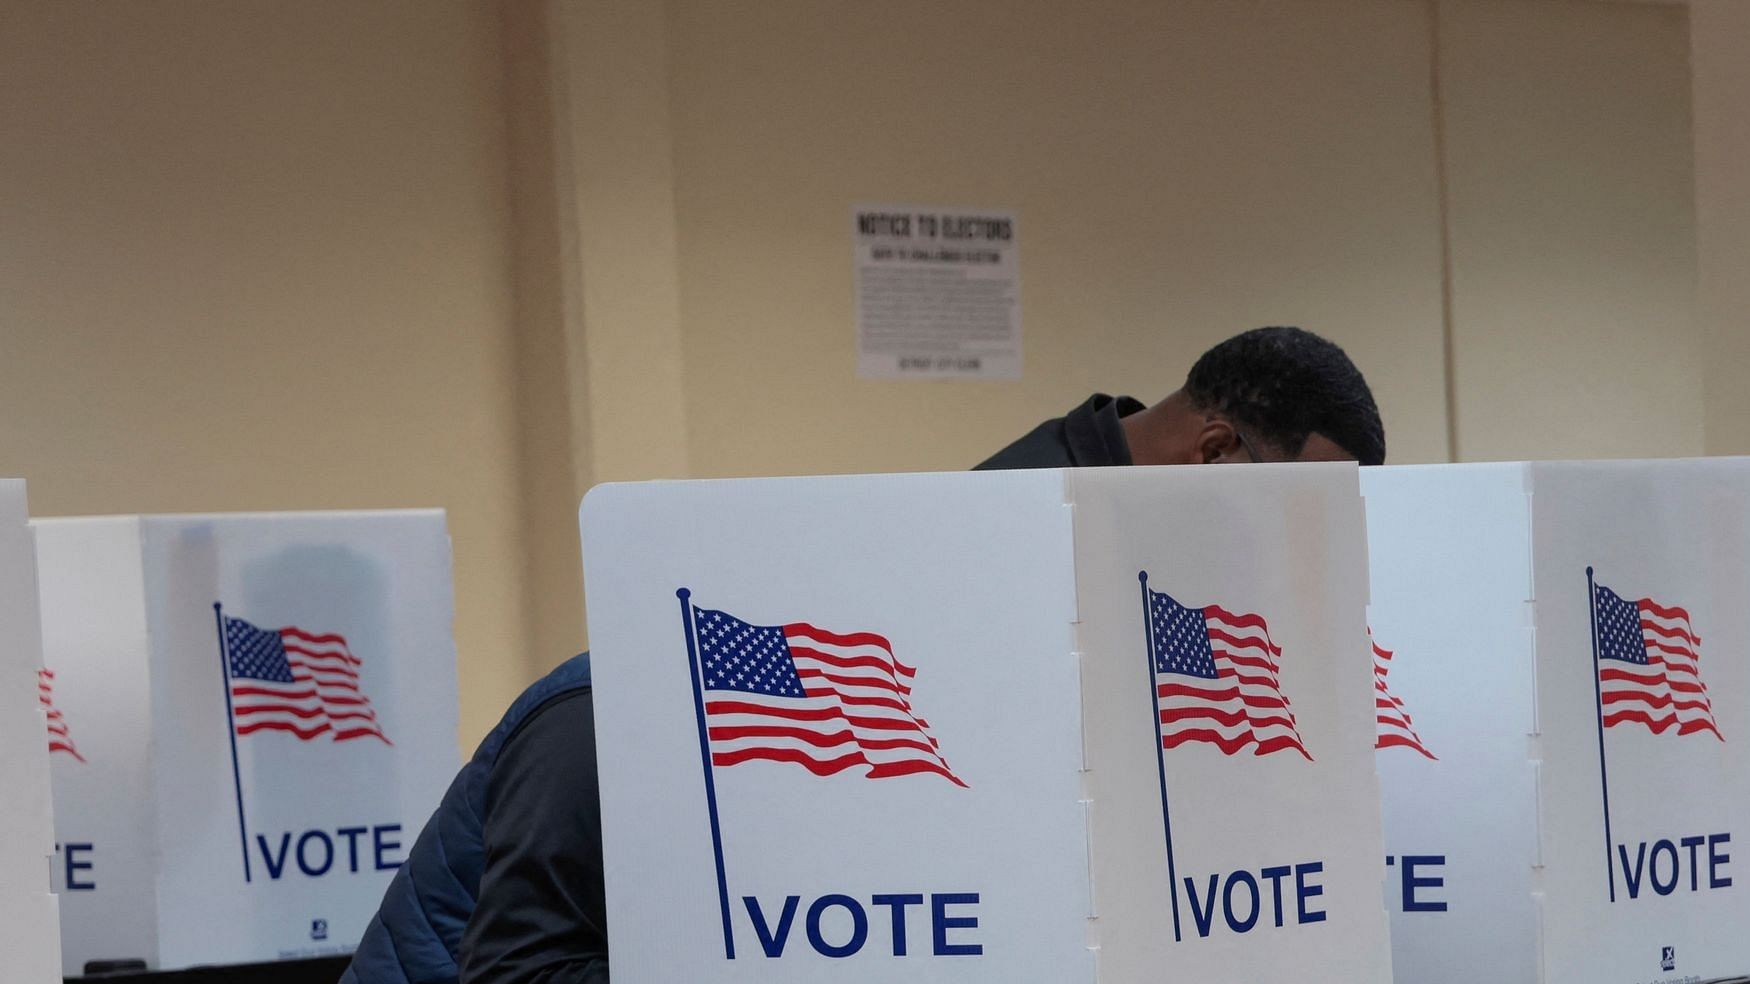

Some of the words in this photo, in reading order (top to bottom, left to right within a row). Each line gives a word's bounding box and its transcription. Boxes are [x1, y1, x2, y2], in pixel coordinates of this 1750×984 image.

[257, 824, 402, 880] VOTE
[1617, 832, 1733, 900] VOTE
[742, 893, 983, 958] VOTE
[1183, 862, 1327, 938] VOTE
